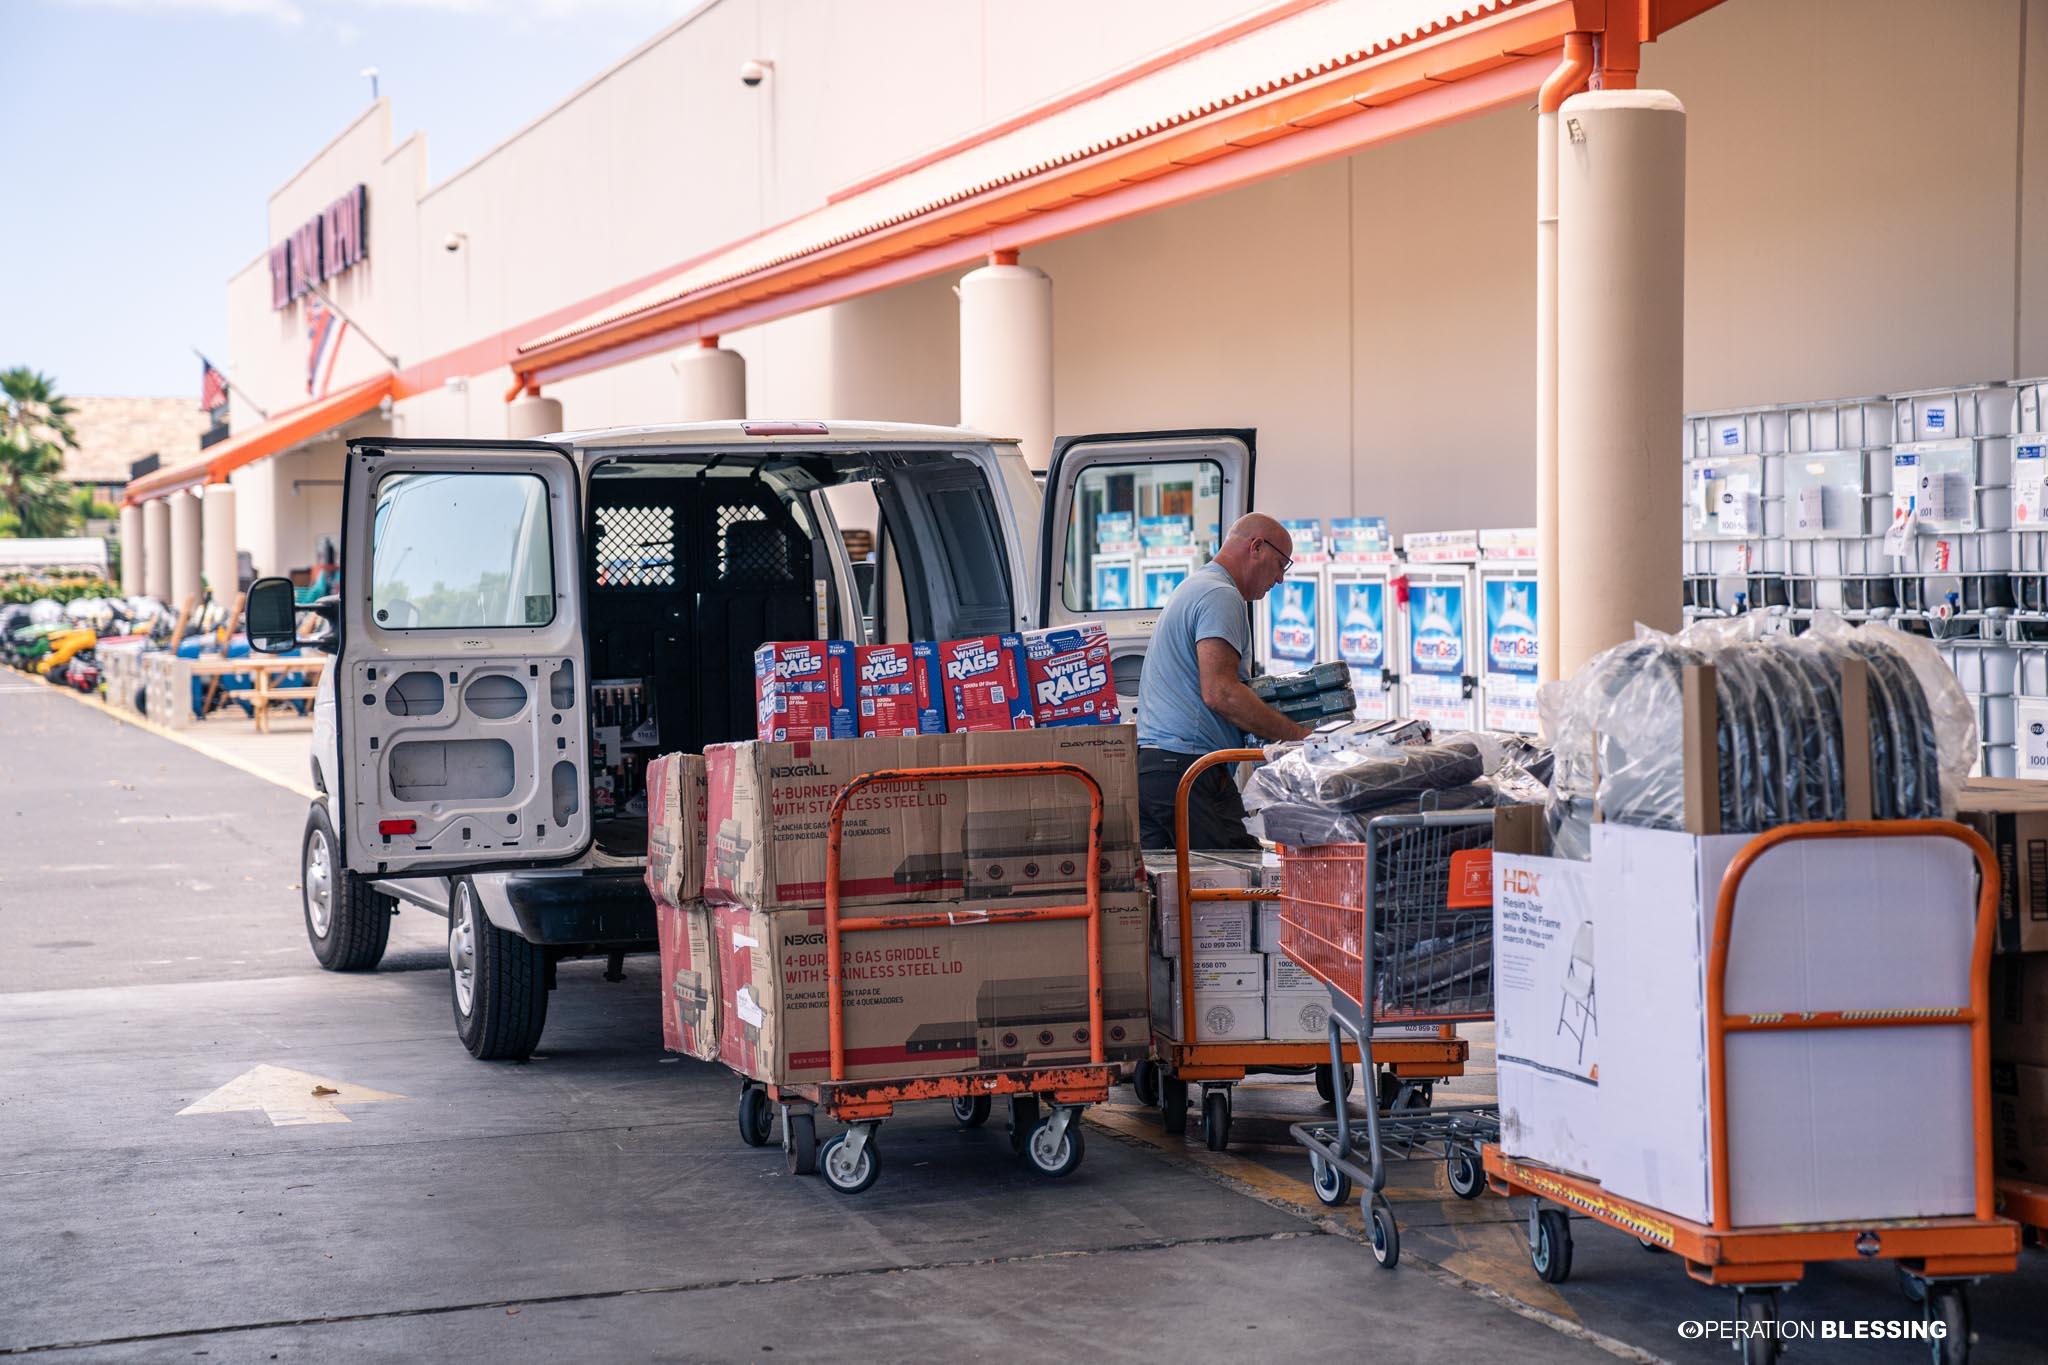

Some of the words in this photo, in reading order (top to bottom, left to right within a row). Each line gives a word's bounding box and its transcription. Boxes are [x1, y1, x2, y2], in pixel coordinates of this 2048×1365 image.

[780, 650, 810, 662] WHITE
[866, 653, 896, 665] WHITE
[952, 646, 986, 661] WHITE
[1050, 652, 1084, 666] PROFESSIONAL
[775, 656, 821, 679] RAGS
[861, 658, 908, 682] RAGS
[946, 650, 1000, 681] RAGS
[1042, 658, 1087, 680] WHITE
[1036, 664, 1107, 706] RAGS
[1060, 739, 1125, 748] DAYTONA
[770, 761, 829, 778] NEXGRILL
[772, 783, 837, 800] 4-BURNER
[871, 780, 926, 794] GRIDDLE
[773, 802, 806, 816] WITH
[884, 796, 925, 808] STEEL
[929, 793, 948, 806] LID
[773, 833, 795, 842] ACERO
[848, 827, 891, 837] QUEMADORES
[774, 824, 803, 832] PLANCHA
[813, 821, 827, 829] GAS
[1503, 868, 1542, 897] HDX
[1503, 895, 1526, 909] Resin
[1503, 910, 1520, 921] with
[1538, 915, 1561, 929] Frame
[855, 950, 882, 964] GAS
[885, 946, 940, 960] GRIDDLE
[785, 969, 819, 984] WITH
[823, 965, 895, 982] SAINLESS
[898, 962, 939, 977] STEEL
[941, 960, 963, 974] LID
[785, 992, 816, 1001] PLANCHA
[817, 991, 826, 999] DE
[854, 989, 872, 997] TAPA
[786, 1002, 808, 1010] ACERO
[861, 996, 904, 1006] QUEMADORES
